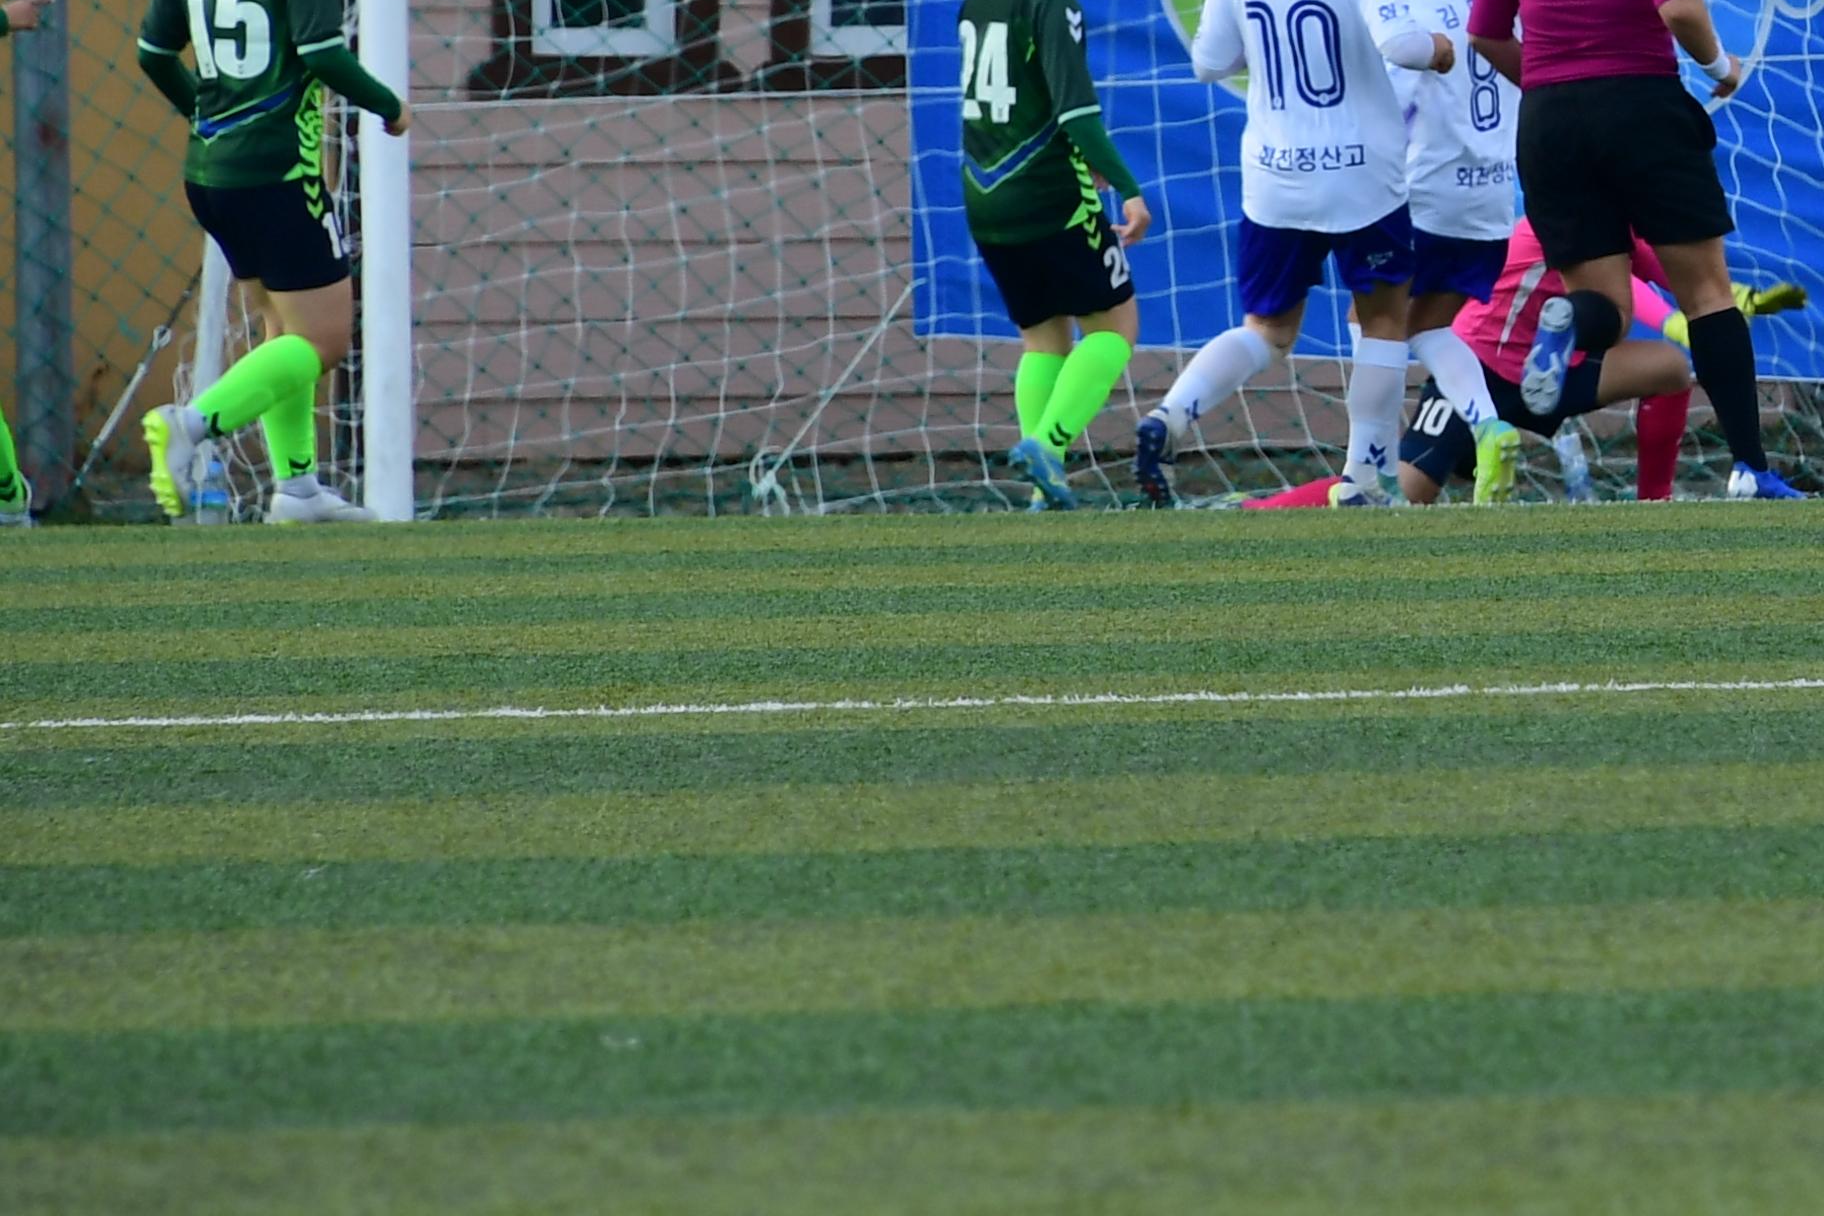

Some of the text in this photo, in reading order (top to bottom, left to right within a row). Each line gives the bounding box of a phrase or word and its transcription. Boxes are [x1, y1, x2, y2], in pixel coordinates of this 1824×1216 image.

[958, 19, 1017, 124] 24
[1466, 43, 1502, 133] 8
[1412, 395, 1454, 437] 10
